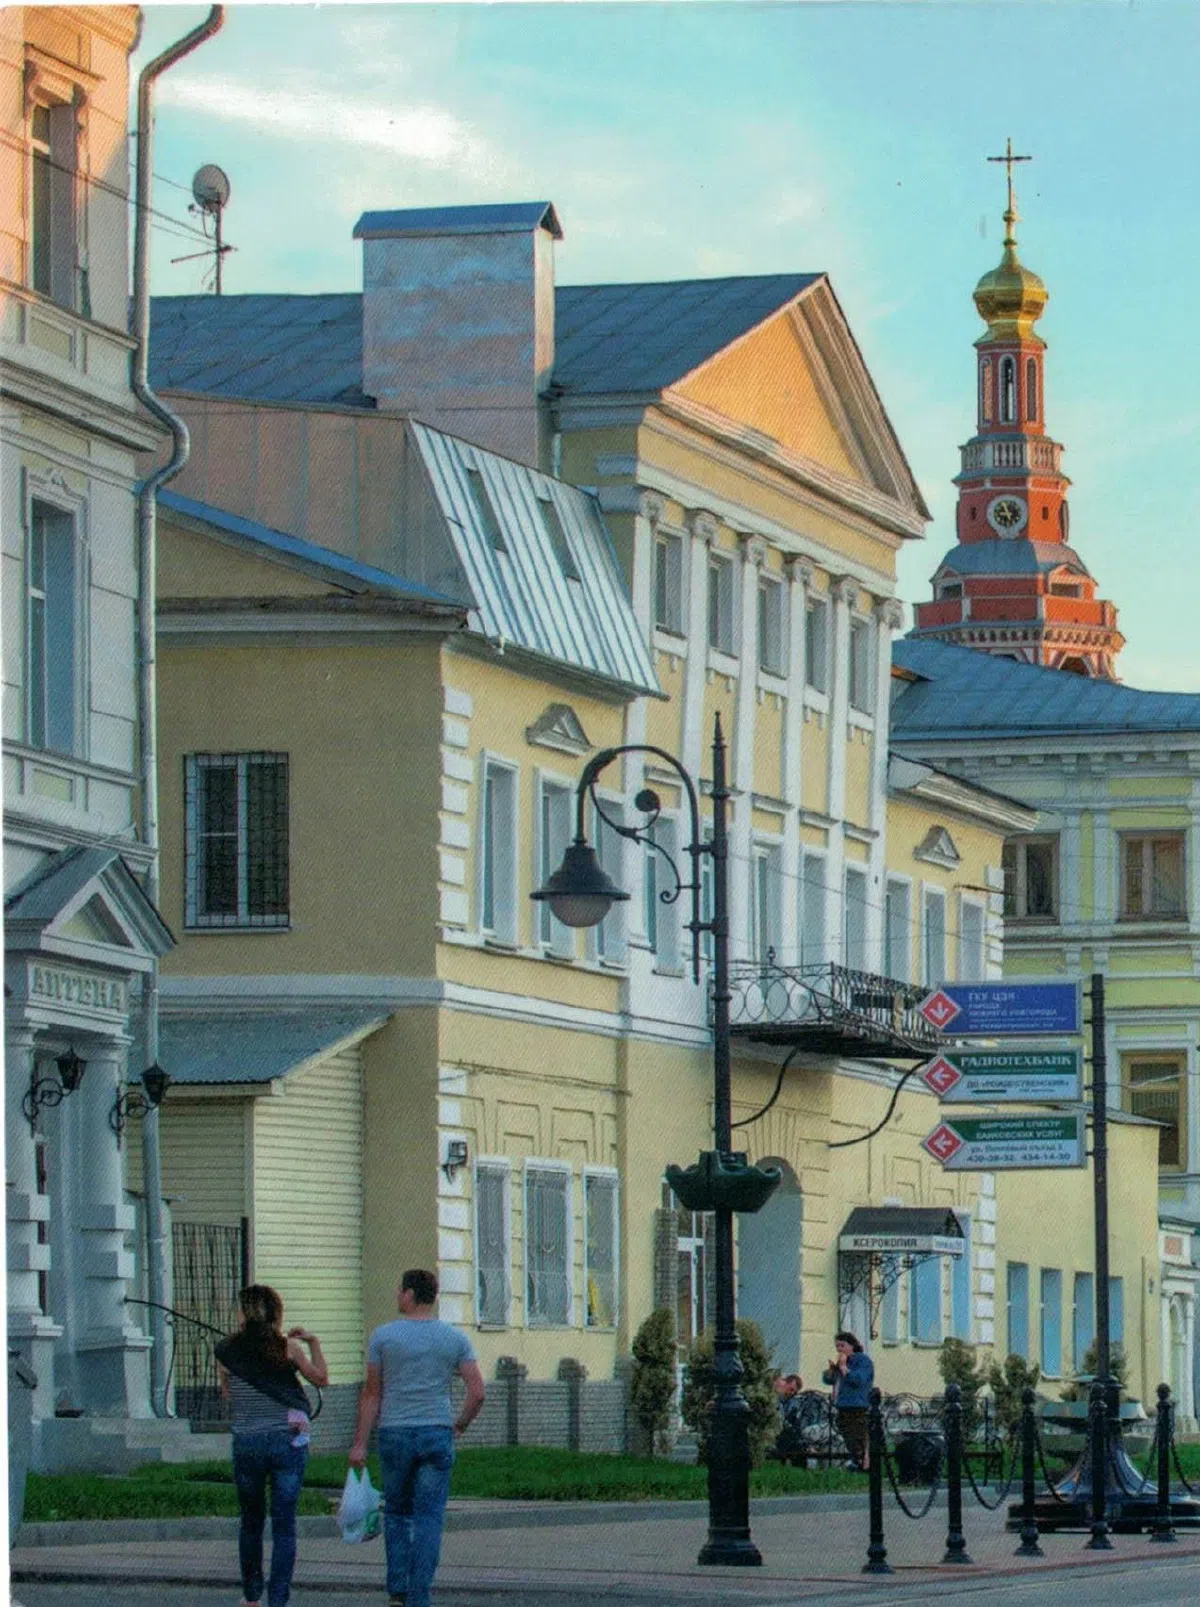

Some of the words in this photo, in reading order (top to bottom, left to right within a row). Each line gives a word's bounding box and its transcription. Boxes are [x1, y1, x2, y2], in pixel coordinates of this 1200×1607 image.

[31, 966, 123, 1011] АПТЕКА
[961, 1055, 1072, 1067] РАДИОТЕХБАНК
[853, 1238, 917, 1248] КСЕРОКОПИЯ
